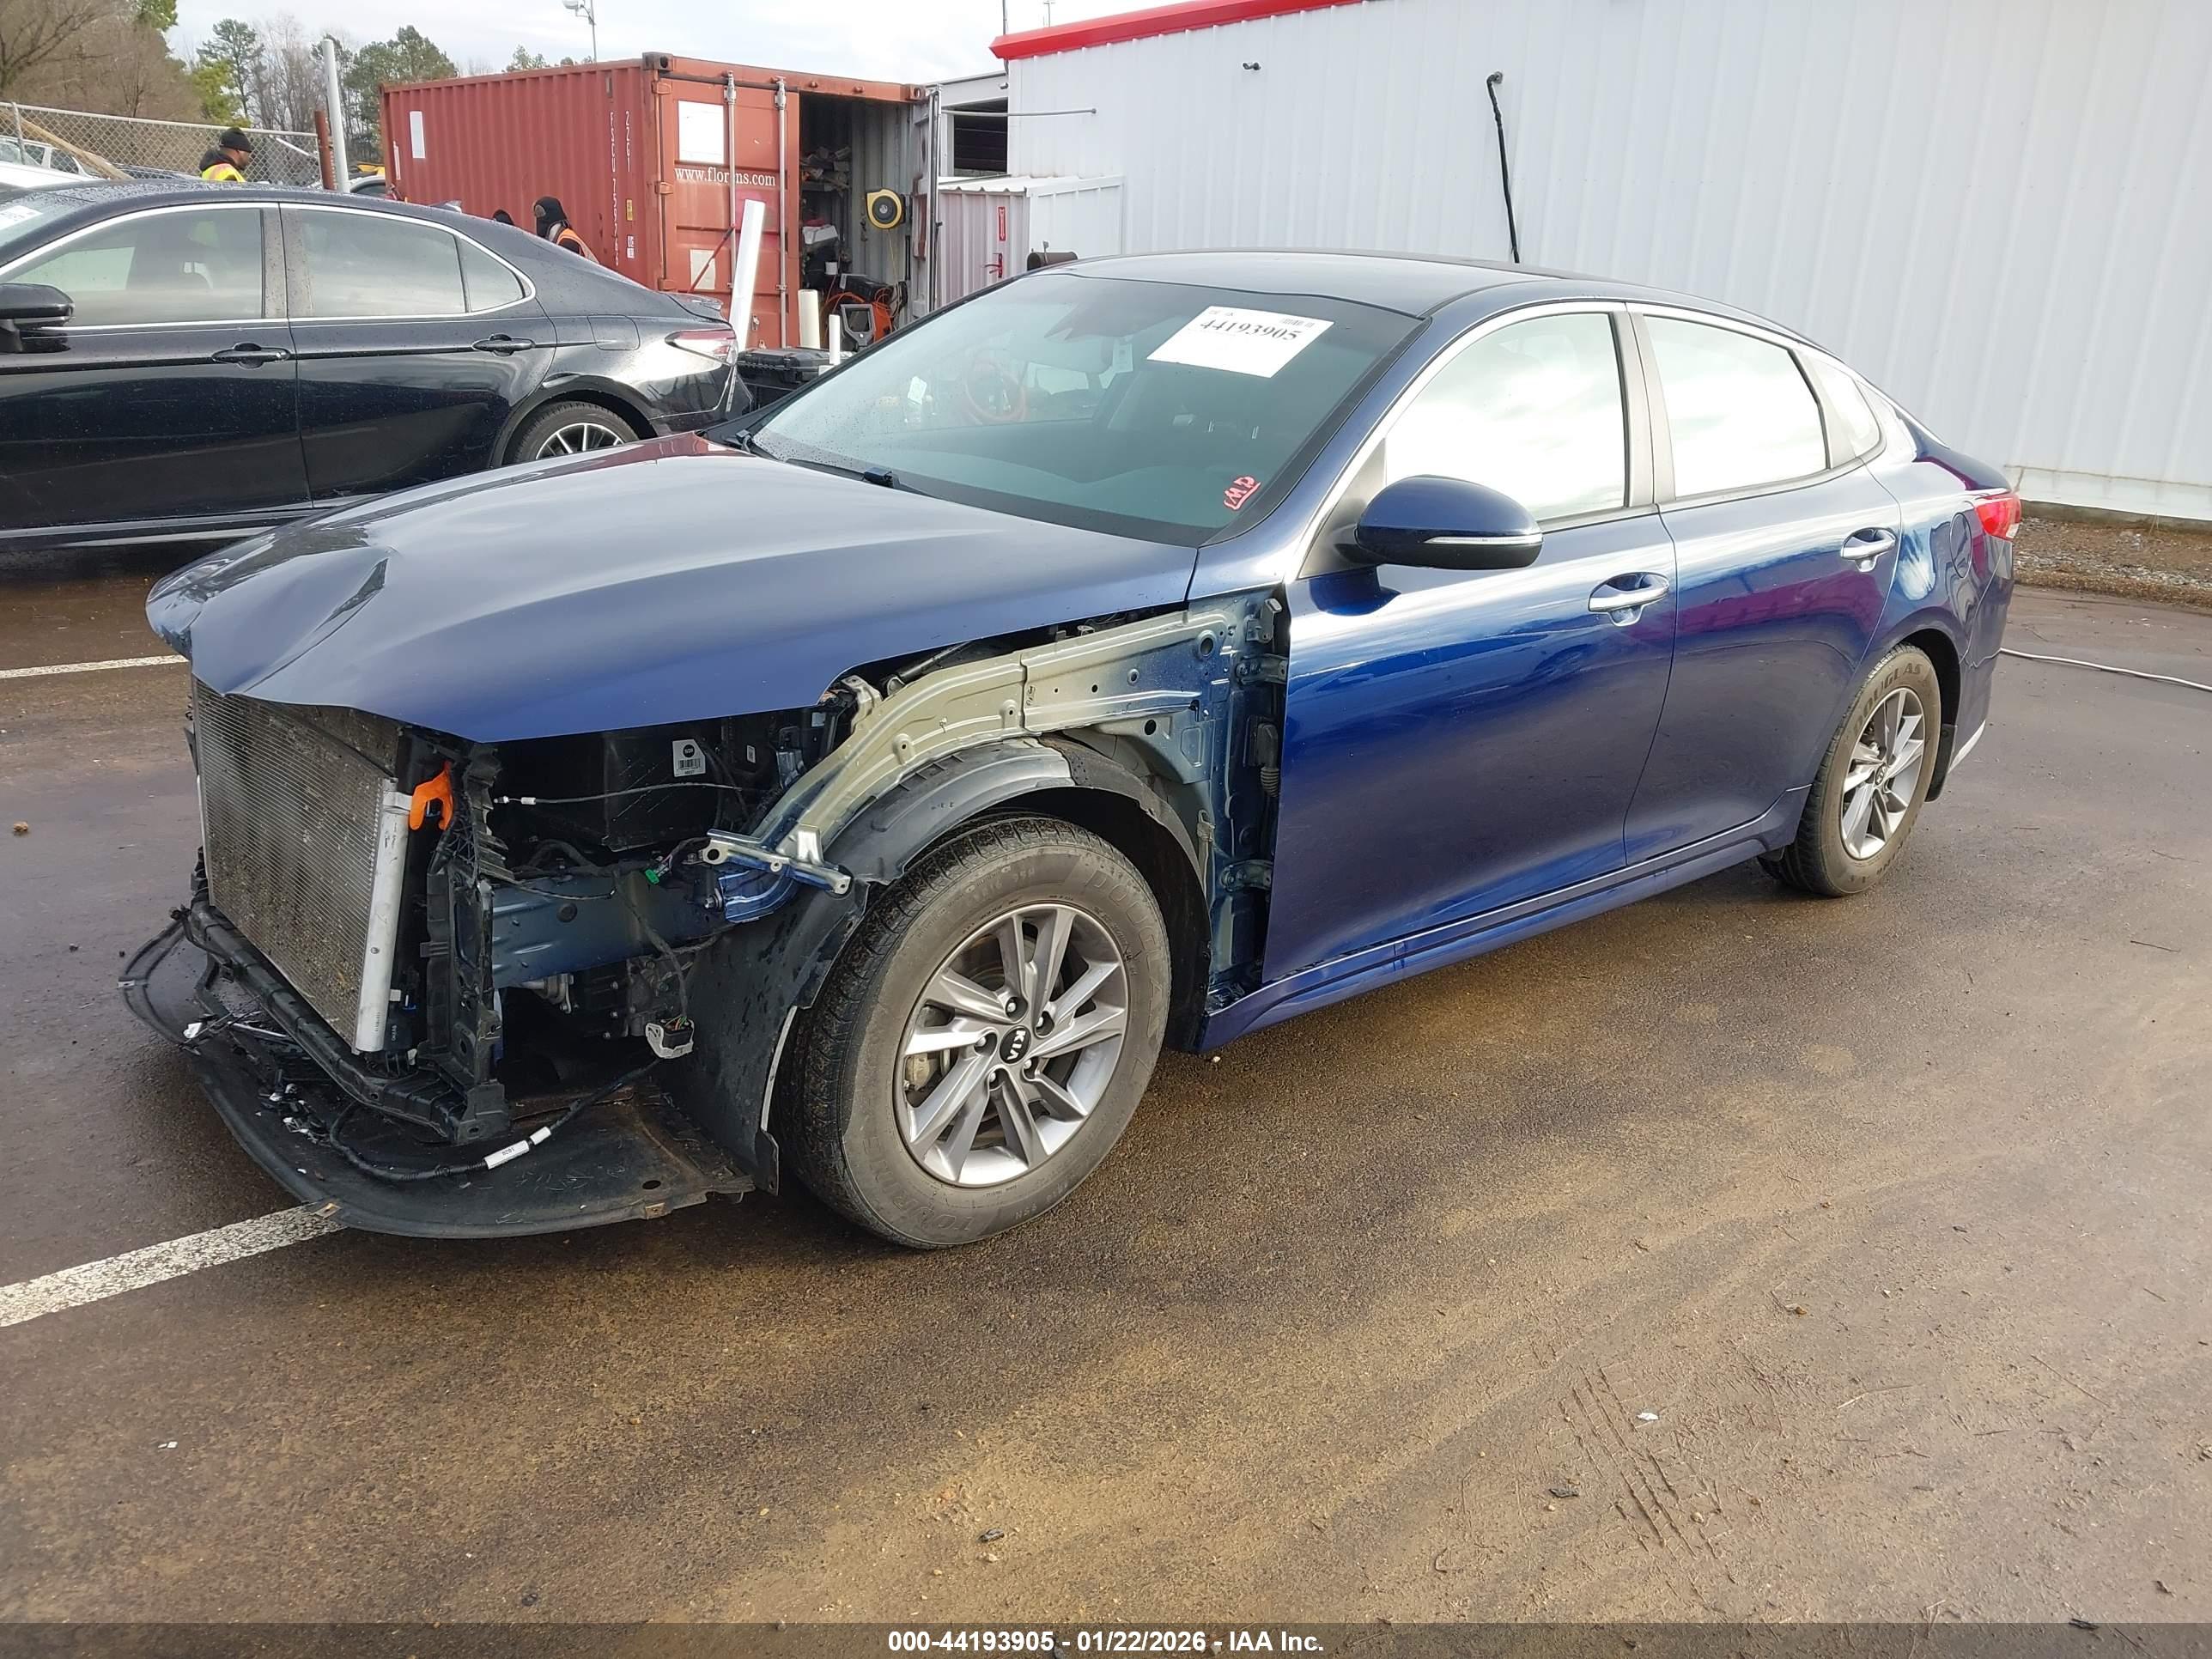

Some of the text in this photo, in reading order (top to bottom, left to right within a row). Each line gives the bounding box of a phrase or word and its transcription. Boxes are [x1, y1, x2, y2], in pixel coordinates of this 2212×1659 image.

[674, 166, 775, 186] www.florns.com
[1200, 319, 1303, 341] 44193905
[1085, 870, 1163, 1038] DOUGLAS
[1006, 1030, 1026, 1060] KIA
